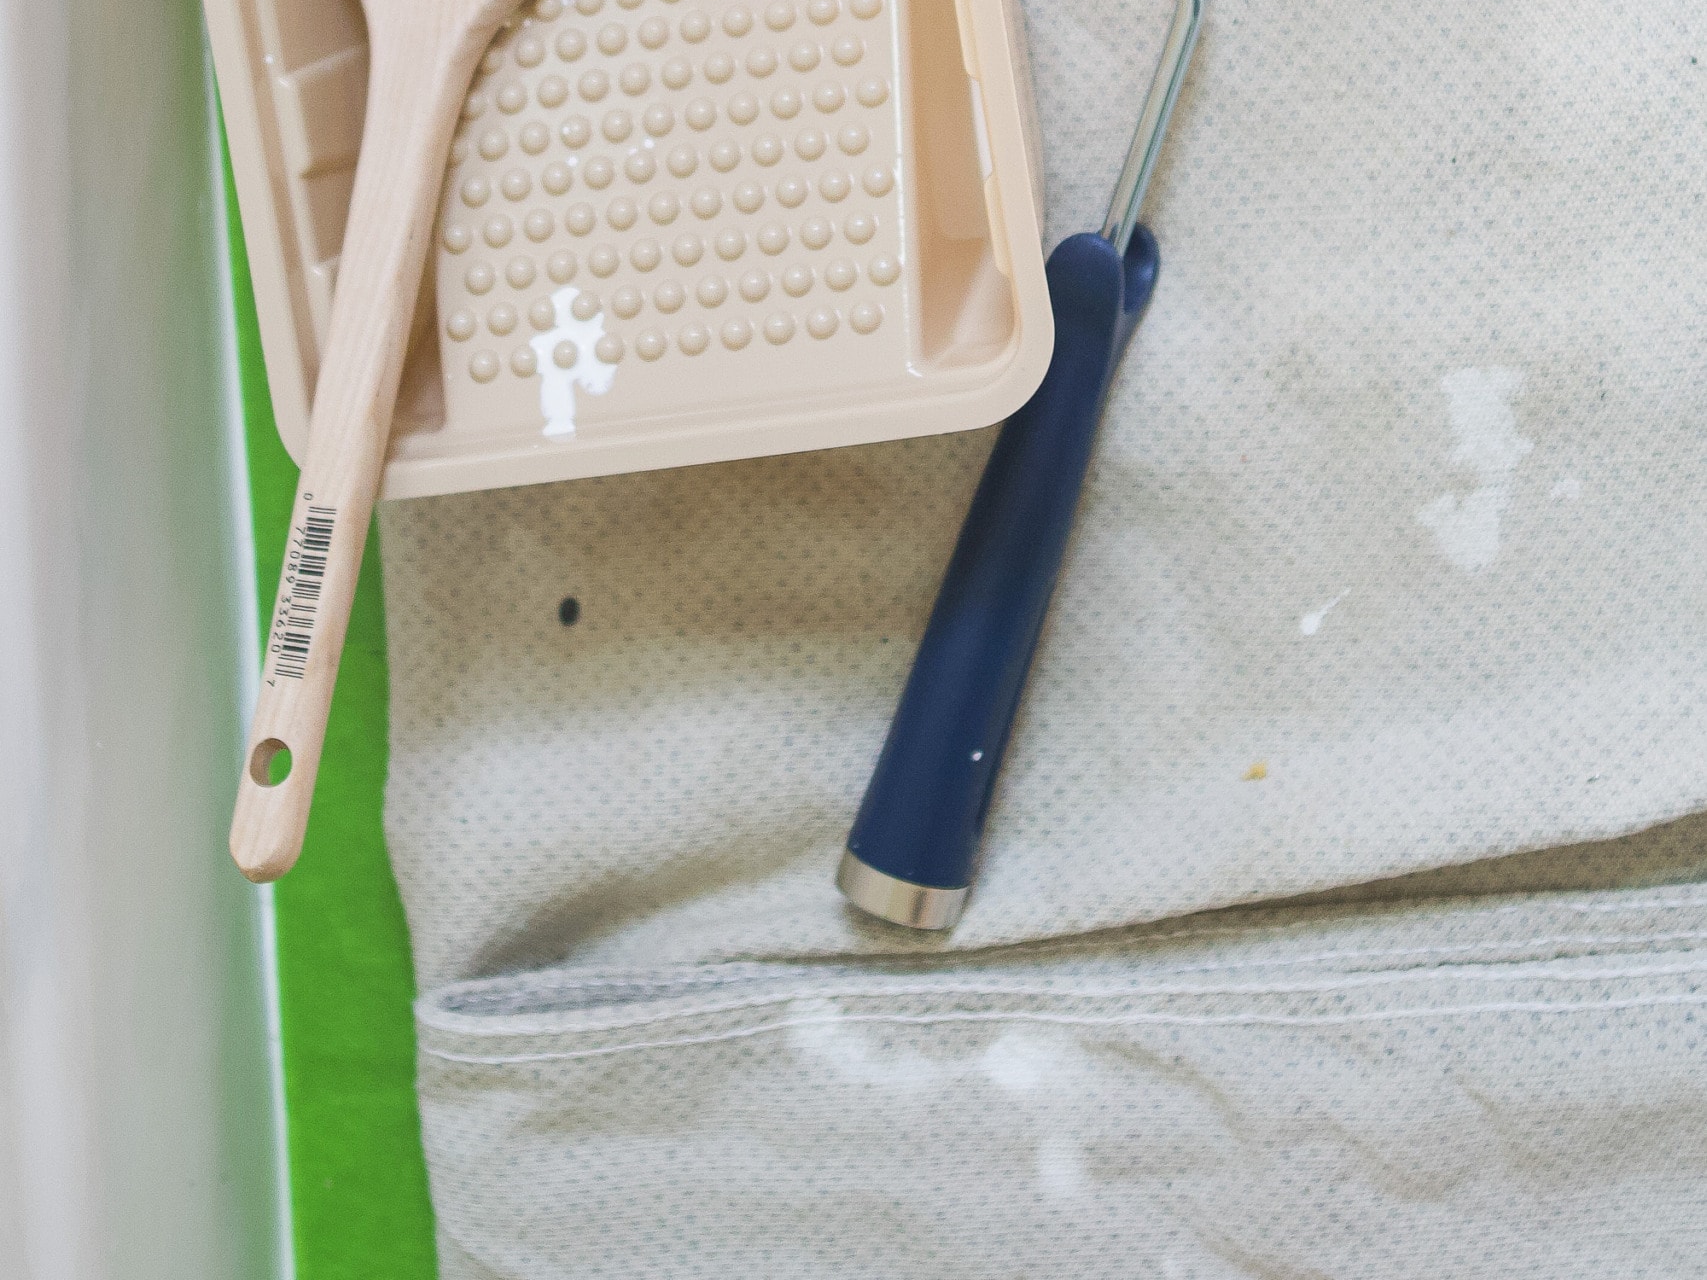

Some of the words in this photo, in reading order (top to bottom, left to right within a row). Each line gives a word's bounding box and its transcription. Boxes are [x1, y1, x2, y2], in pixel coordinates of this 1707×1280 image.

[303, 492, 314, 501] 0
[285, 526, 306, 583] 77089
[271, 596, 292, 654] 33620
[266, 679, 276, 688] 7
